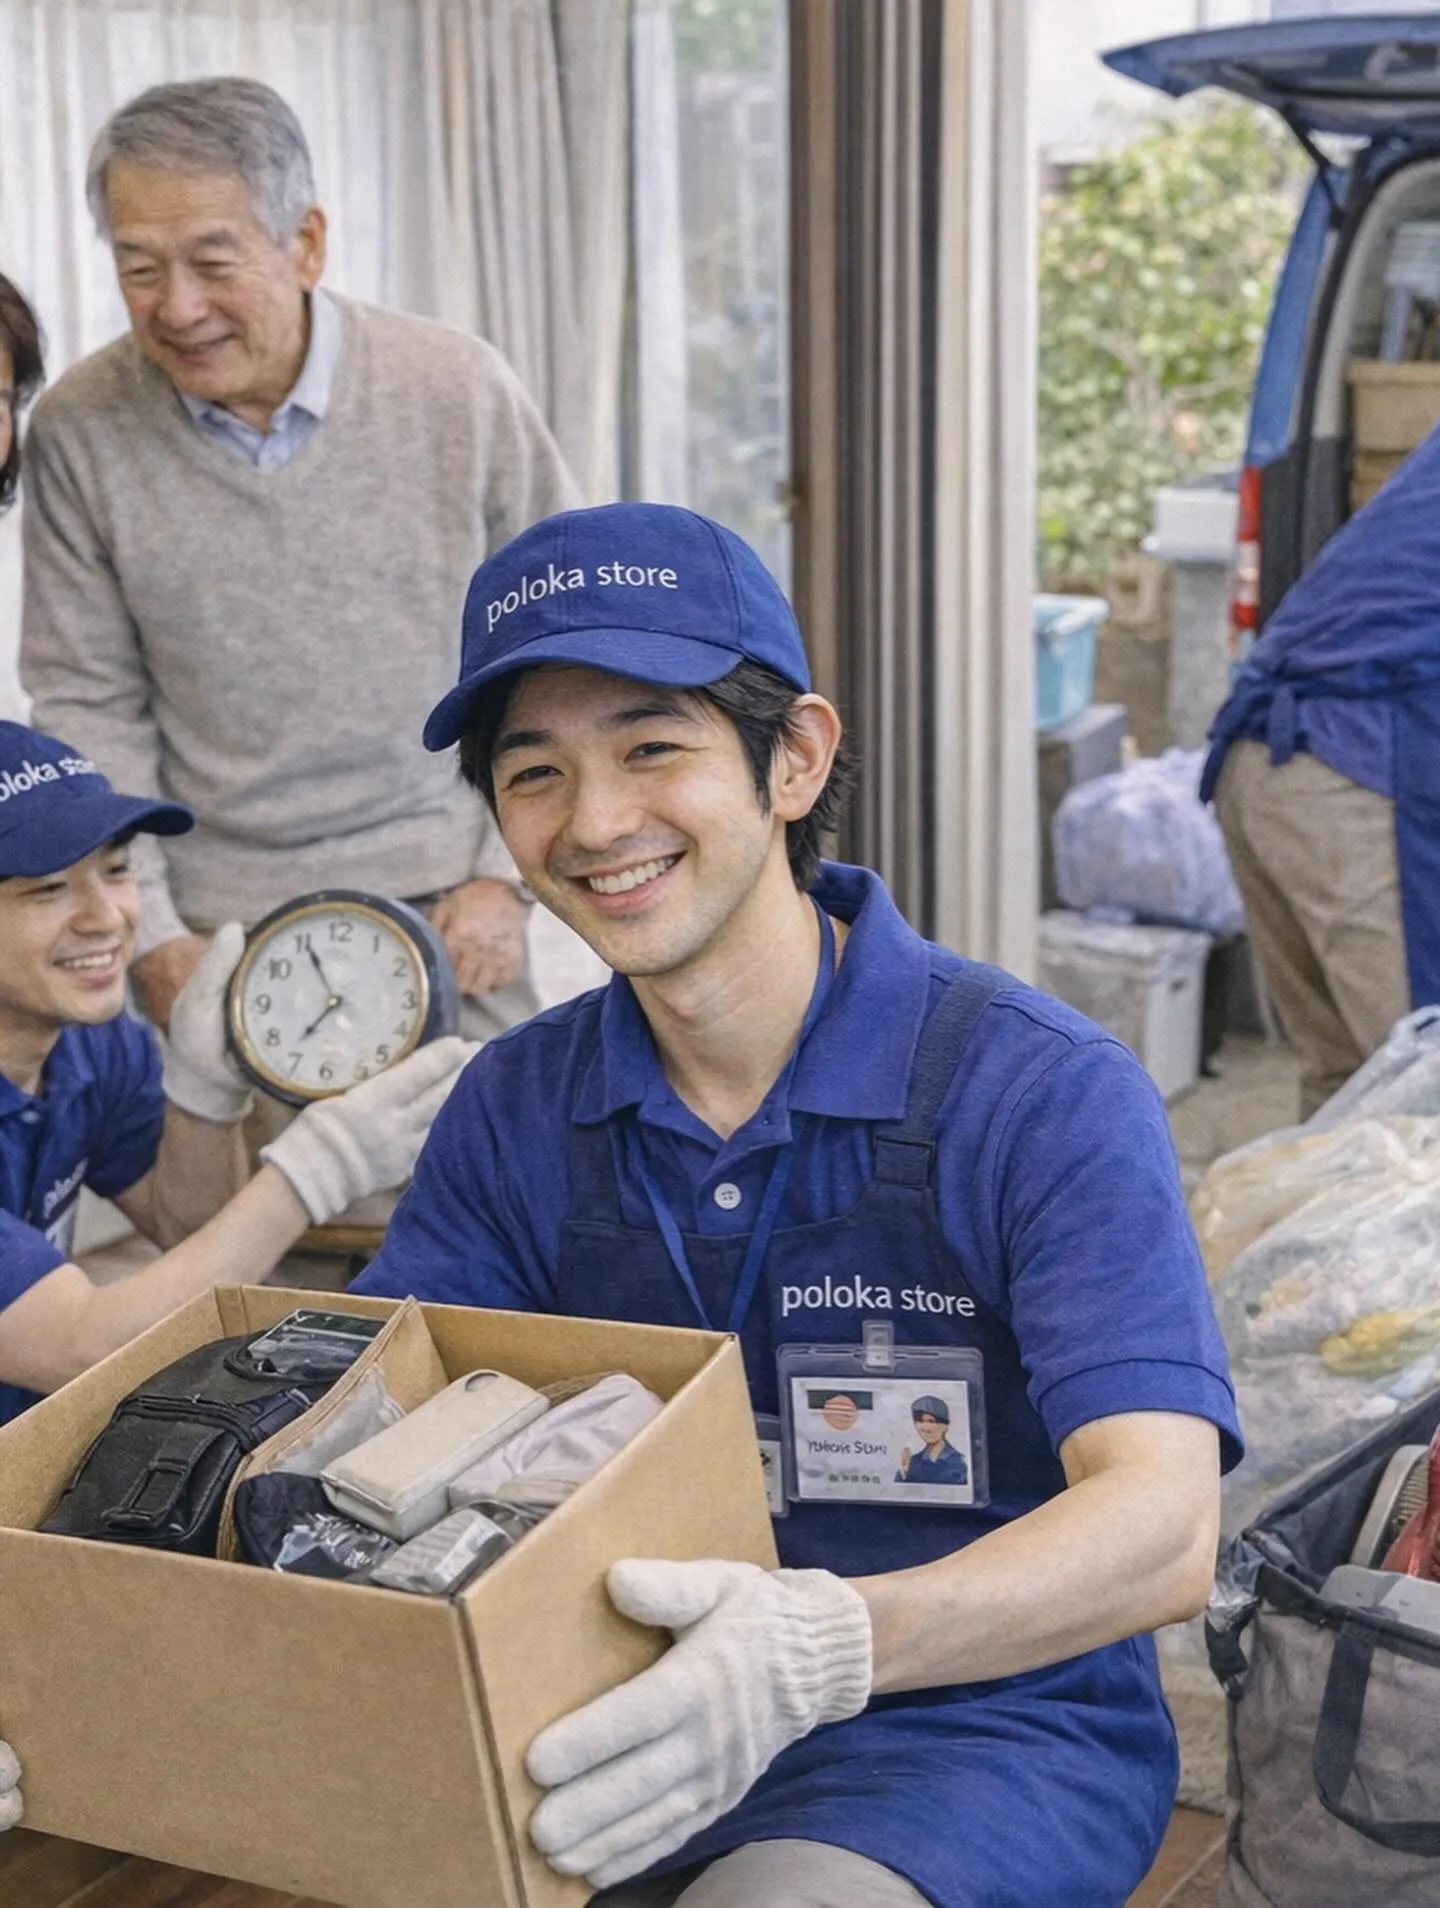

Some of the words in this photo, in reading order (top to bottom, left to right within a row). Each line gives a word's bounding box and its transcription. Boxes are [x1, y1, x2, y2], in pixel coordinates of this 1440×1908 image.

[487, 564, 585, 633] poloka
[597, 561, 678, 589] store
[329, 921, 353, 943] 12
[294, 932, 312, 955] 11
[372, 934, 380, 954] 1
[269, 957, 293, 981] 10
[392, 957, 408, 977] 2
[257, 994, 271, 1015] 9
[401, 990, 417, 1009] 3
[266, 1027, 281, 1048] 8
[391, 1020, 409, 1038] 4
[287, 1051, 304, 1072] 7
[375, 1043, 390, 1064] 5
[319, 1063, 334, 1082] 6
[782, 1275, 892, 1317] poloka
[901, 1284, 976, 1317] store
